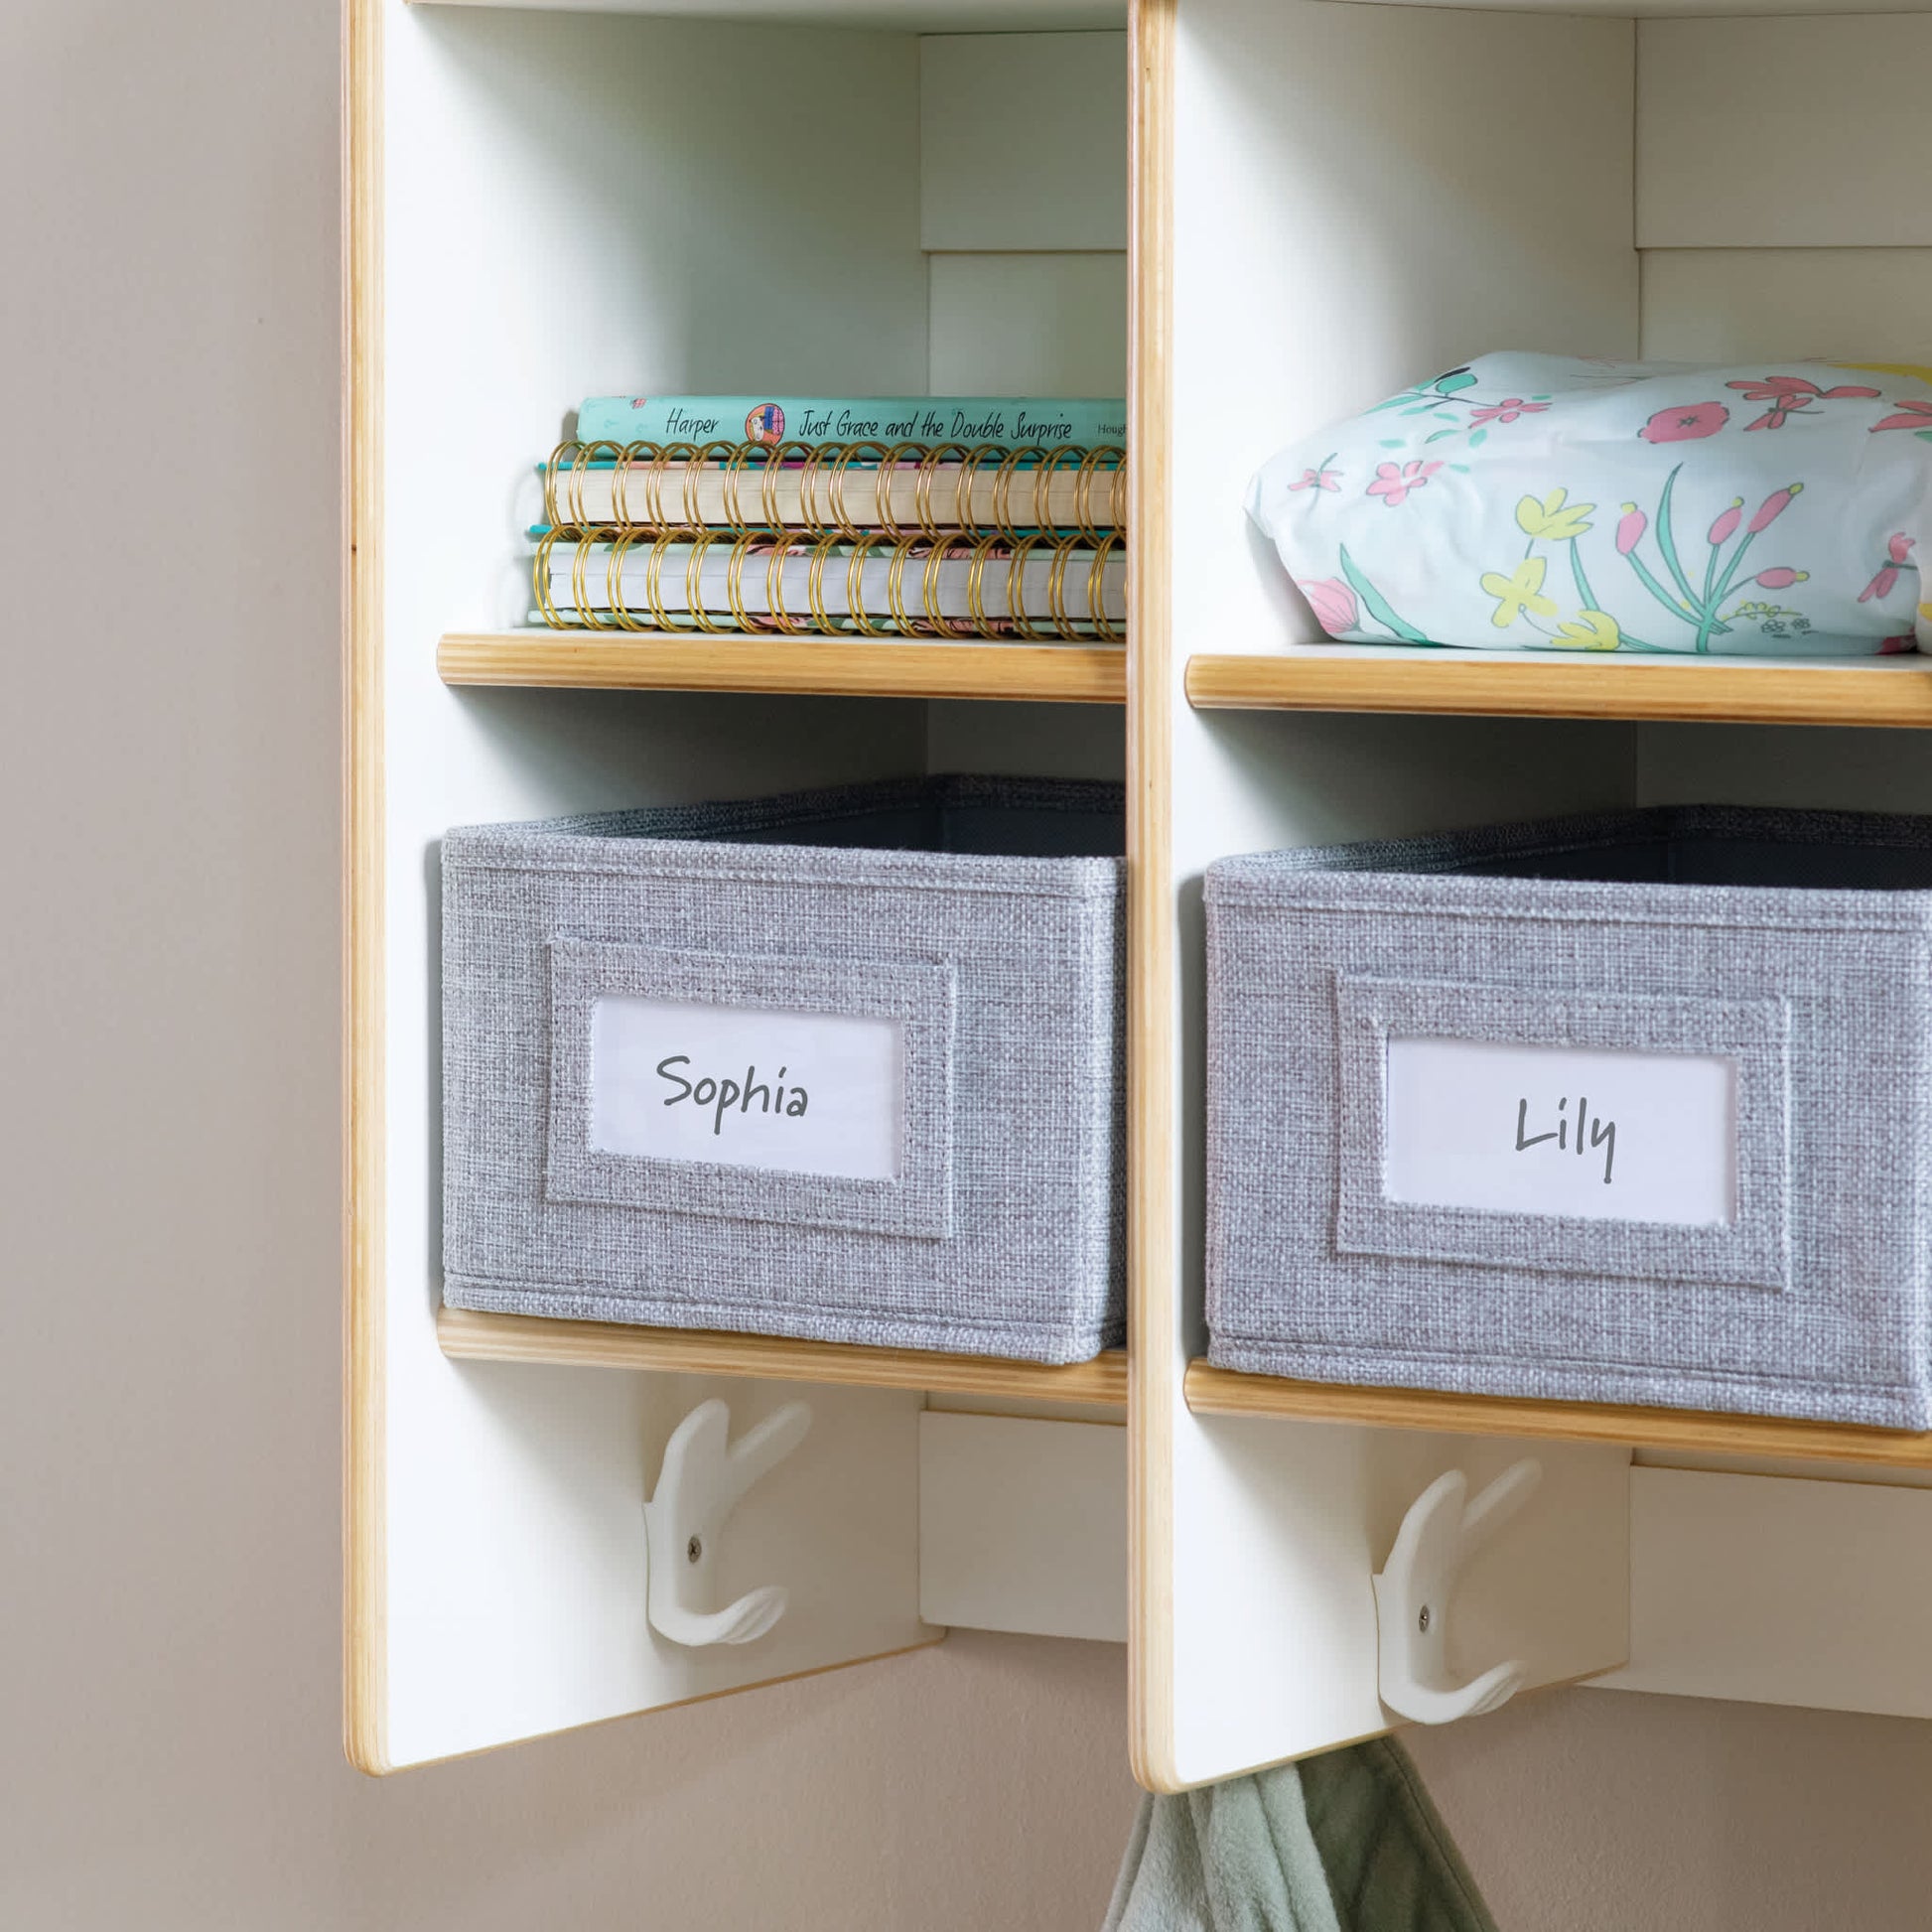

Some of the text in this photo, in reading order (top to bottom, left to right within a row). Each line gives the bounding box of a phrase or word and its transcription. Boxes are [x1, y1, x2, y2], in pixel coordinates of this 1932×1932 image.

[665, 407, 720, 441] Harper
[799, 409, 1072, 446] Just Grace and the Double Surprise
[656, 1055, 808, 1135] Sophia
[1515, 1097, 1616, 1184] Lily
